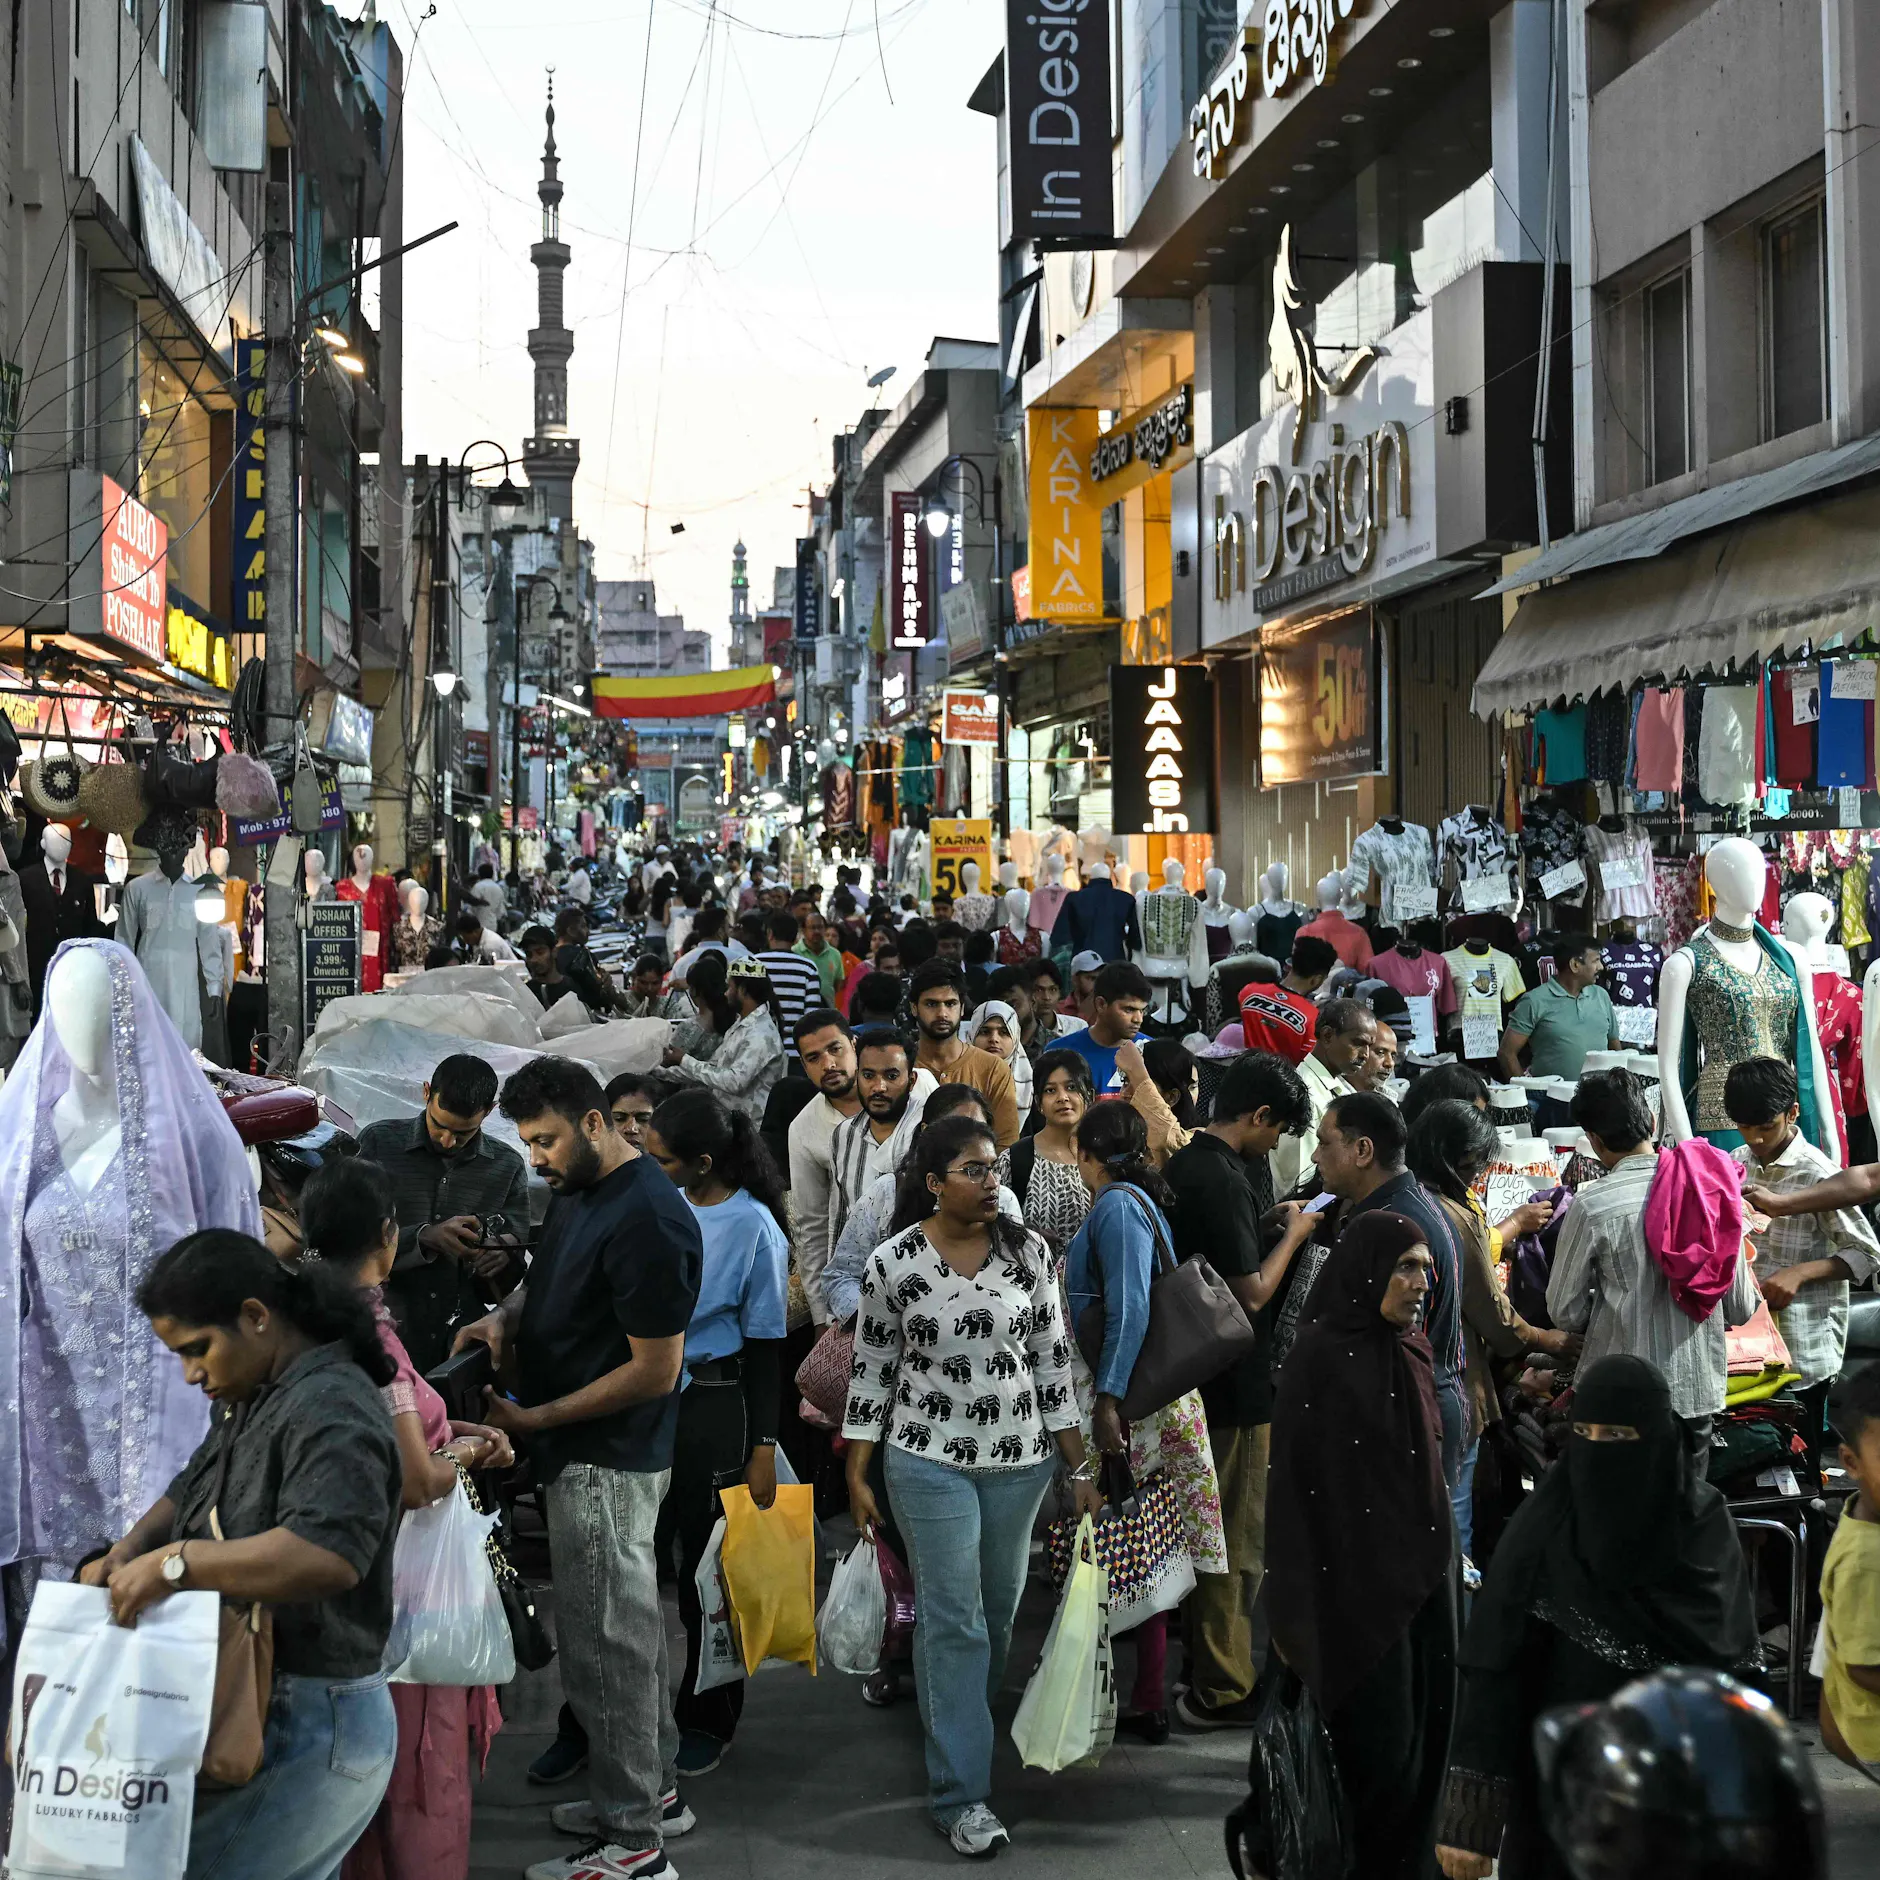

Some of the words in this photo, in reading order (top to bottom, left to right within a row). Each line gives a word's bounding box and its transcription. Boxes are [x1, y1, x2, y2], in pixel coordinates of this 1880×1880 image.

[1026, 0, 1089, 146] Desi
[1031, 170, 1082, 219] In
[1048, 415, 1085, 597] KARINA
[1252, 420, 1411, 582] Design
[116, 490, 158, 561] AURO
[110, 542, 148, 602] Shifted
[149, 569, 161, 609] To
[1256, 579, 1292, 609] LUXURY
[1295, 560, 1338, 593] FABRICS
[1038, 602, 1096, 613] FABRICS
[106, 591, 162, 660] POSHAAK
[950, 704, 998, 717] SAL
[1143, 667, 1184, 808] JAAAS
[239, 822, 263, 835] Mob
[934, 835, 987, 845] KARINA
[313, 925, 348, 937] OFFERS
[321, 943, 341, 954] SUIT
[313, 966, 349, 976] Onwards
[1488, 963, 1498, 996] FASHION
[315, 985, 348, 996] BLAZER
[1489, 1175, 1524, 1190] LONG
[1501, 1189, 1535, 1206] SKIR
[20, 1761, 45, 1795] In
[53, 1765, 170, 1811] Design
[35, 1804, 84, 1818] LUXURY
[87, 1809, 141, 1824] FABRICS
